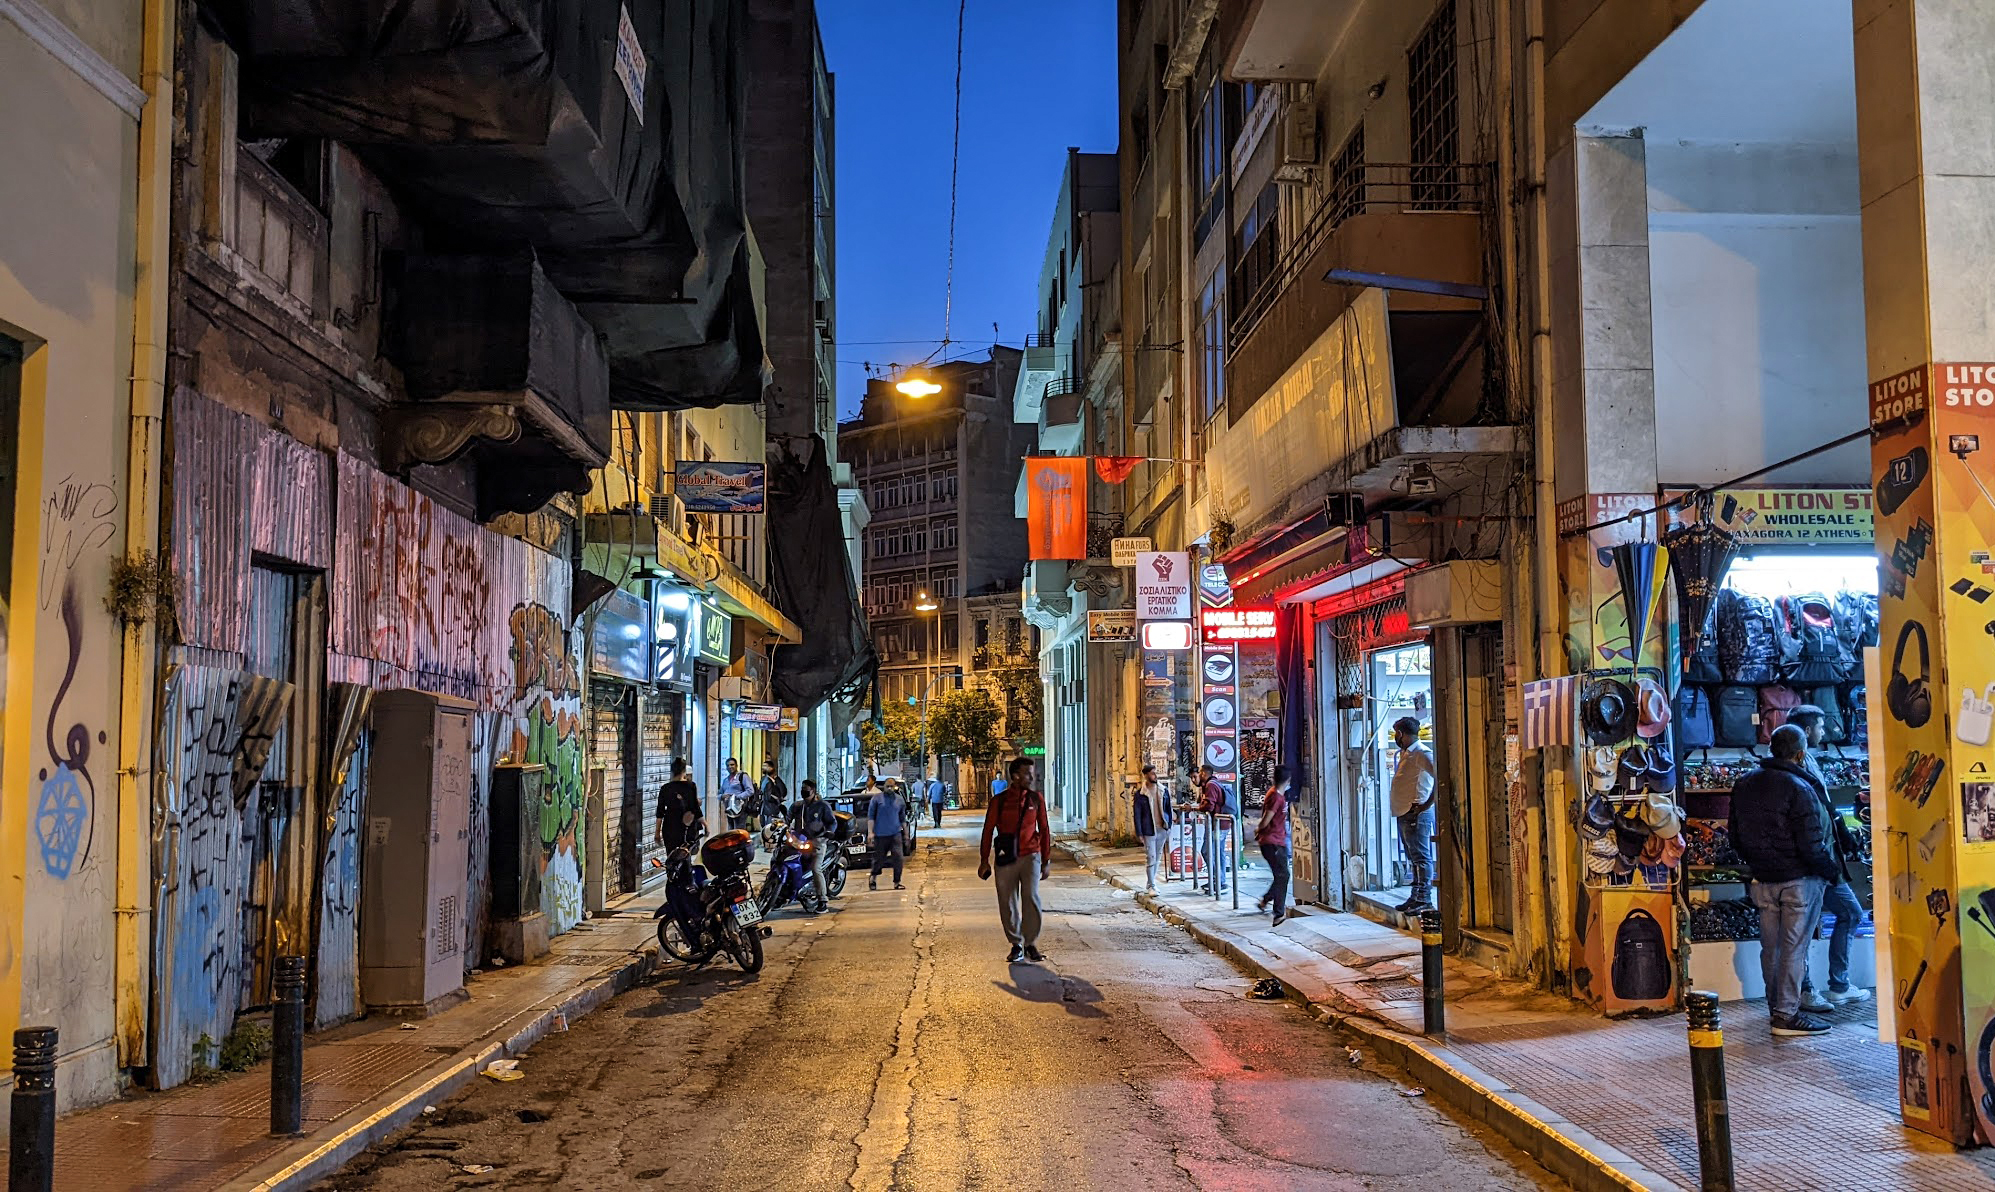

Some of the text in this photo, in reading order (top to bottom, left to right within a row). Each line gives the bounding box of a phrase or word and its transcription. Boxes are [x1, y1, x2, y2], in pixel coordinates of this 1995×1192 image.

[1875, 371, 1921, 402] LITON
[1946, 388, 1994, 407] STO
[1875, 392, 1924, 425] STORE
[1894, 461, 1907, 481] 12
[676, 474, 747, 487] Global Travel
[1560, 498, 1583, 517] LITON
[1758, 493, 1873, 510] LITON ST
[1560, 513, 1585, 531] STORE
[1765, 515, 1854, 525] WHOLESALE
[1797, 530, 1810, 538] 12
[1815, 530, 1860, 538] ATHENS
[1135, 540, 1150, 550] FURS
[1139, 586, 1187, 595] ΣΟΣΙΑΛΙΣΤΙΚΟ
[1147, 596, 1178, 605] ΕΡΓΑΤΙΚΟ
[1148, 606, 1178, 615] ΚΟΜΜΑ
[742, 910, 761, 922] 832
